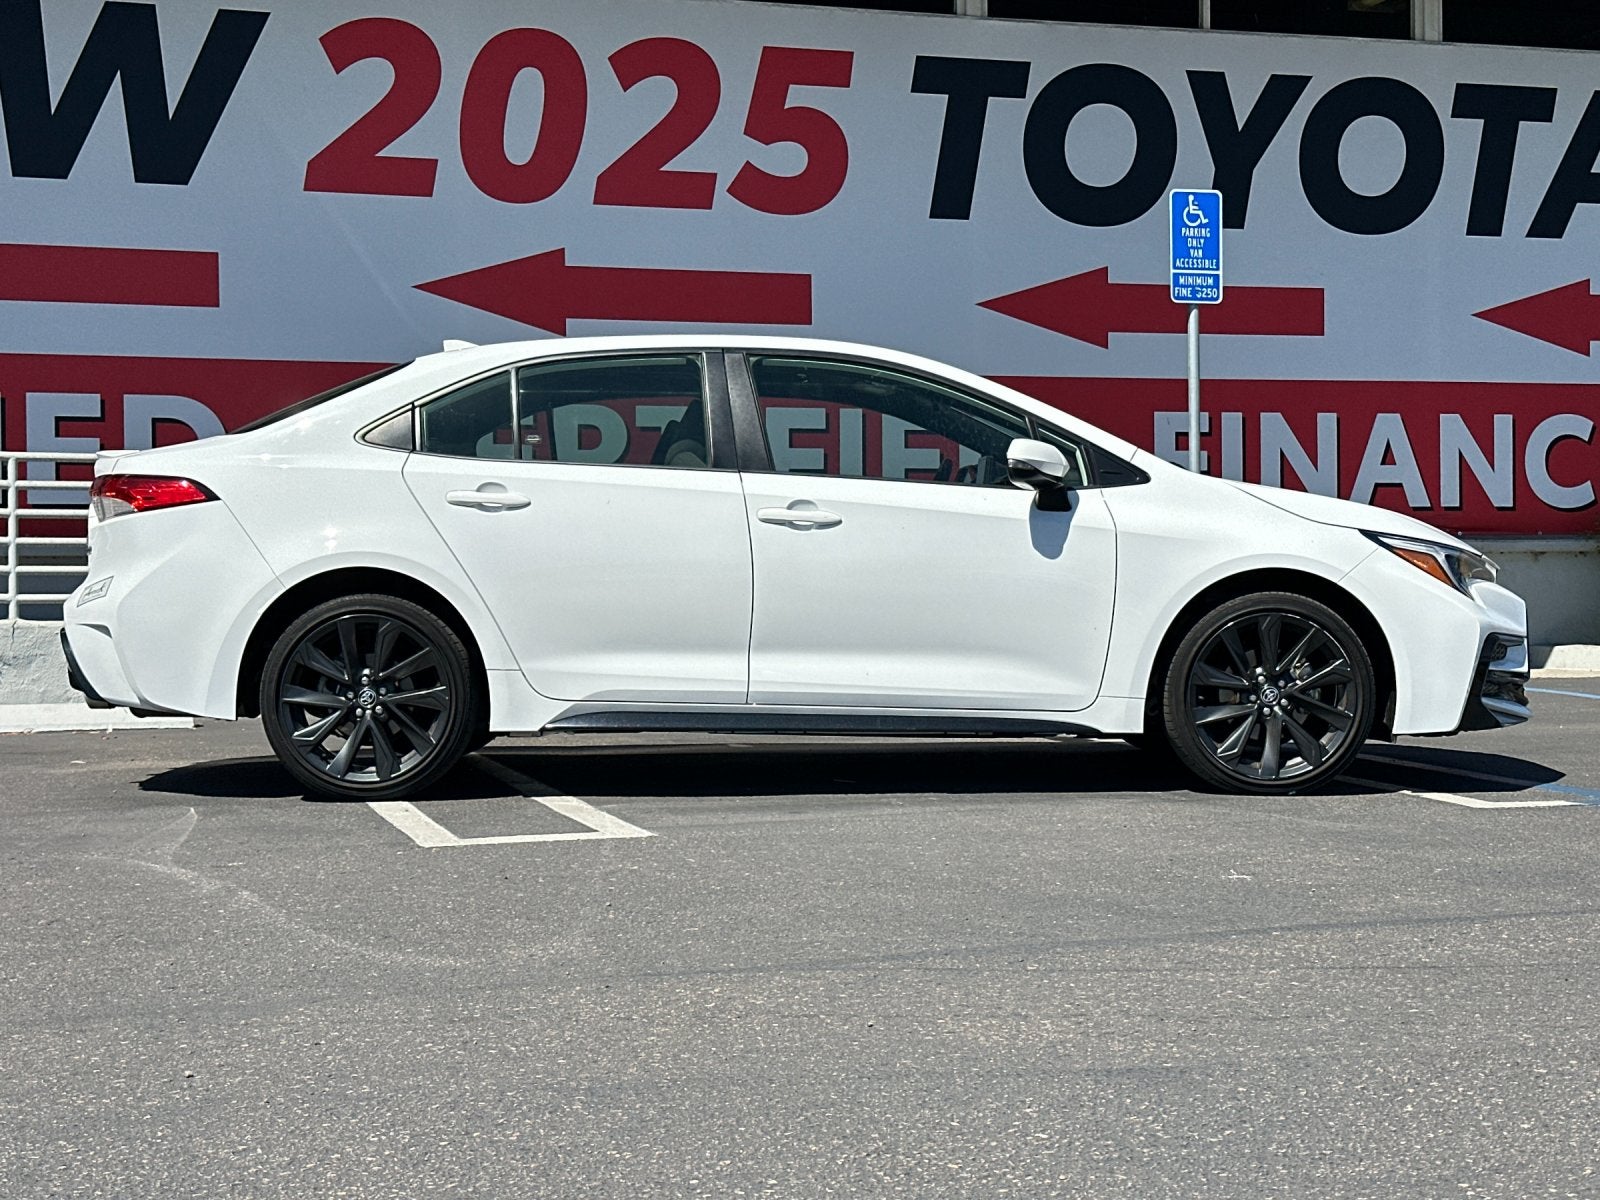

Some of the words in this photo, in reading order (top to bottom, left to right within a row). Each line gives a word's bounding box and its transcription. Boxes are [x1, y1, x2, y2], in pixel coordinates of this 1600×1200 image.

[0, 0, 271, 186] W
[304, 17, 853, 215] 2025
[1181, 227, 1211, 237] PARKING
[1187, 238, 1205, 248] ONLY
[1189, 248, 1203, 258] VAN
[1175, 258, 1217, 268] ACCESSIBLE
[1178, 275, 1214, 286] MINIMUM
[1174, 287, 1193, 297] FINE
